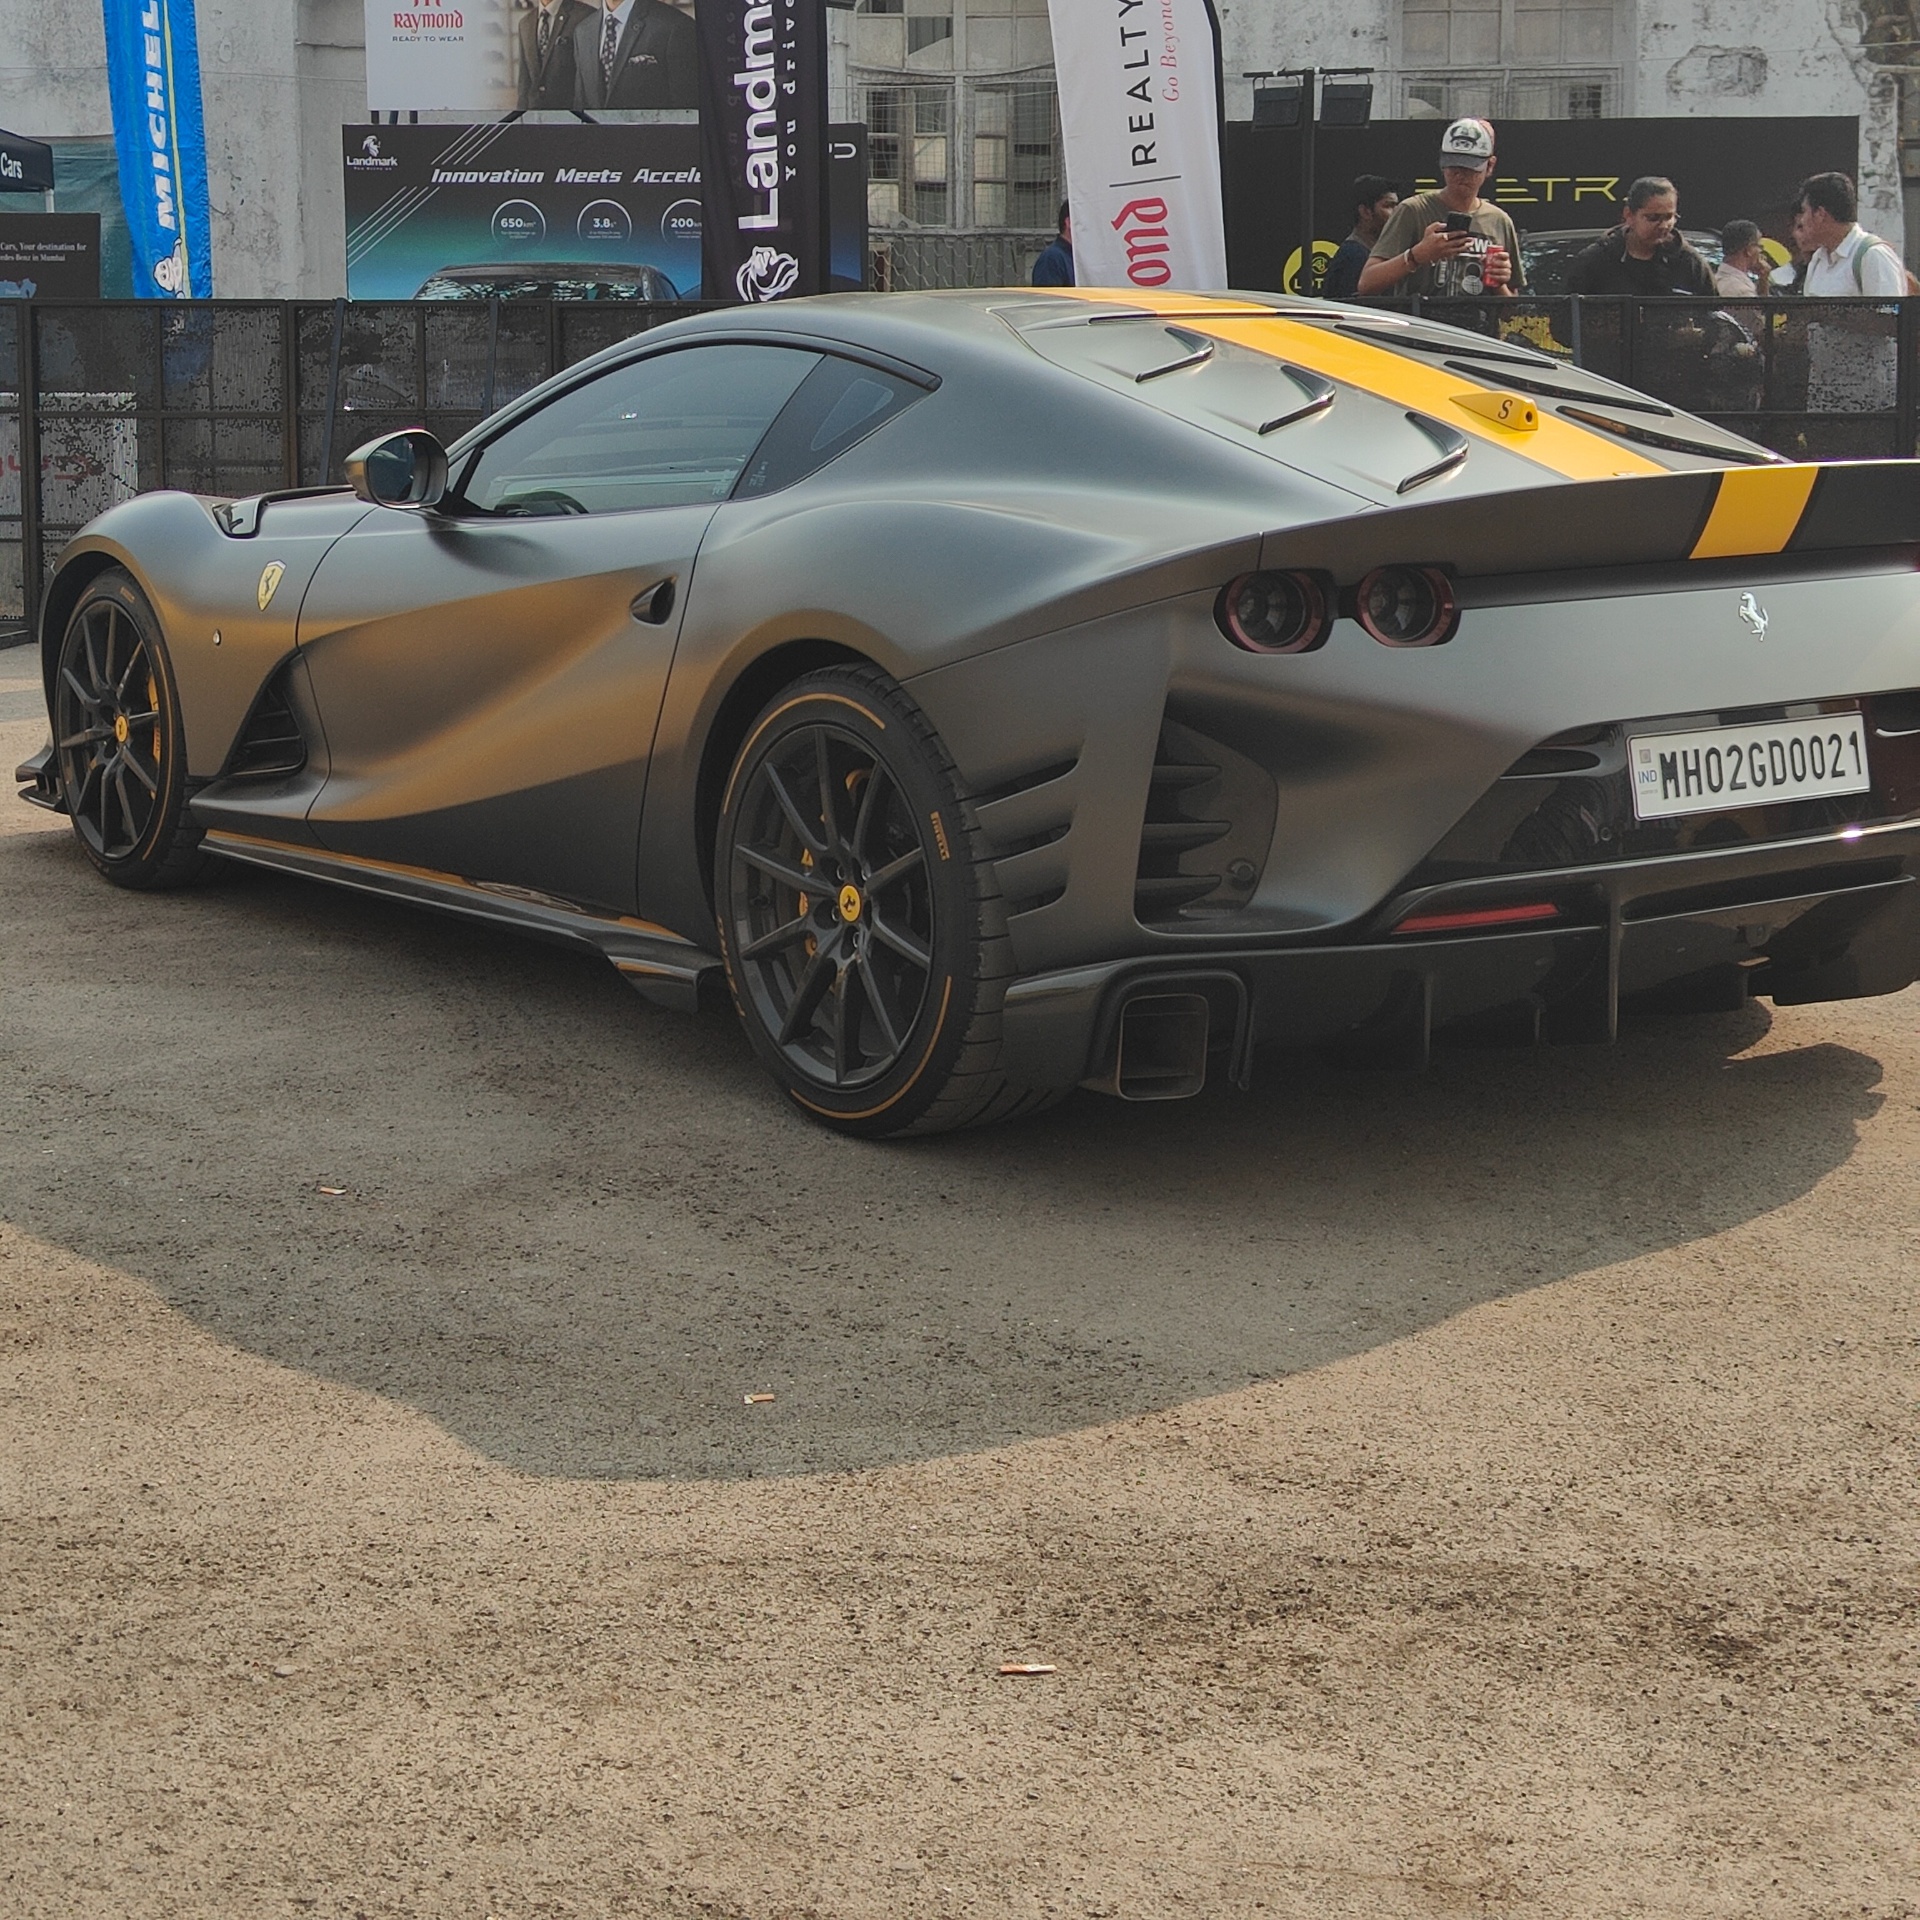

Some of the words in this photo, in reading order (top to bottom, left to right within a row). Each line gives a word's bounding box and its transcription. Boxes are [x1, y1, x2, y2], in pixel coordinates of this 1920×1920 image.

[393, 10, 463, 33] Raymond
[1118, 0, 1157, 166] REALTY
[1162, 77, 1180, 102] Go
[734, 0, 778, 230] Landm
[346, 155, 399, 167] Landmark
[785, 120, 797, 181] You
[0, 152, 23, 180] Cars
[431, 168, 544, 184] Innovation
[555, 168, 623, 184] Meets
[1415, 177, 1626, 202] EETR
[19, 242, 36, 251] Your
[37, 242, 75, 251] destination
[76, 243, 87, 251] for
[32, 253, 39, 261] in
[40, 253, 66, 261] Mumbai
[1497, 399, 1513, 420] S
[1637, 769, 1658, 784] IND
[1659, 731, 1863, 800] MH02GD0021
